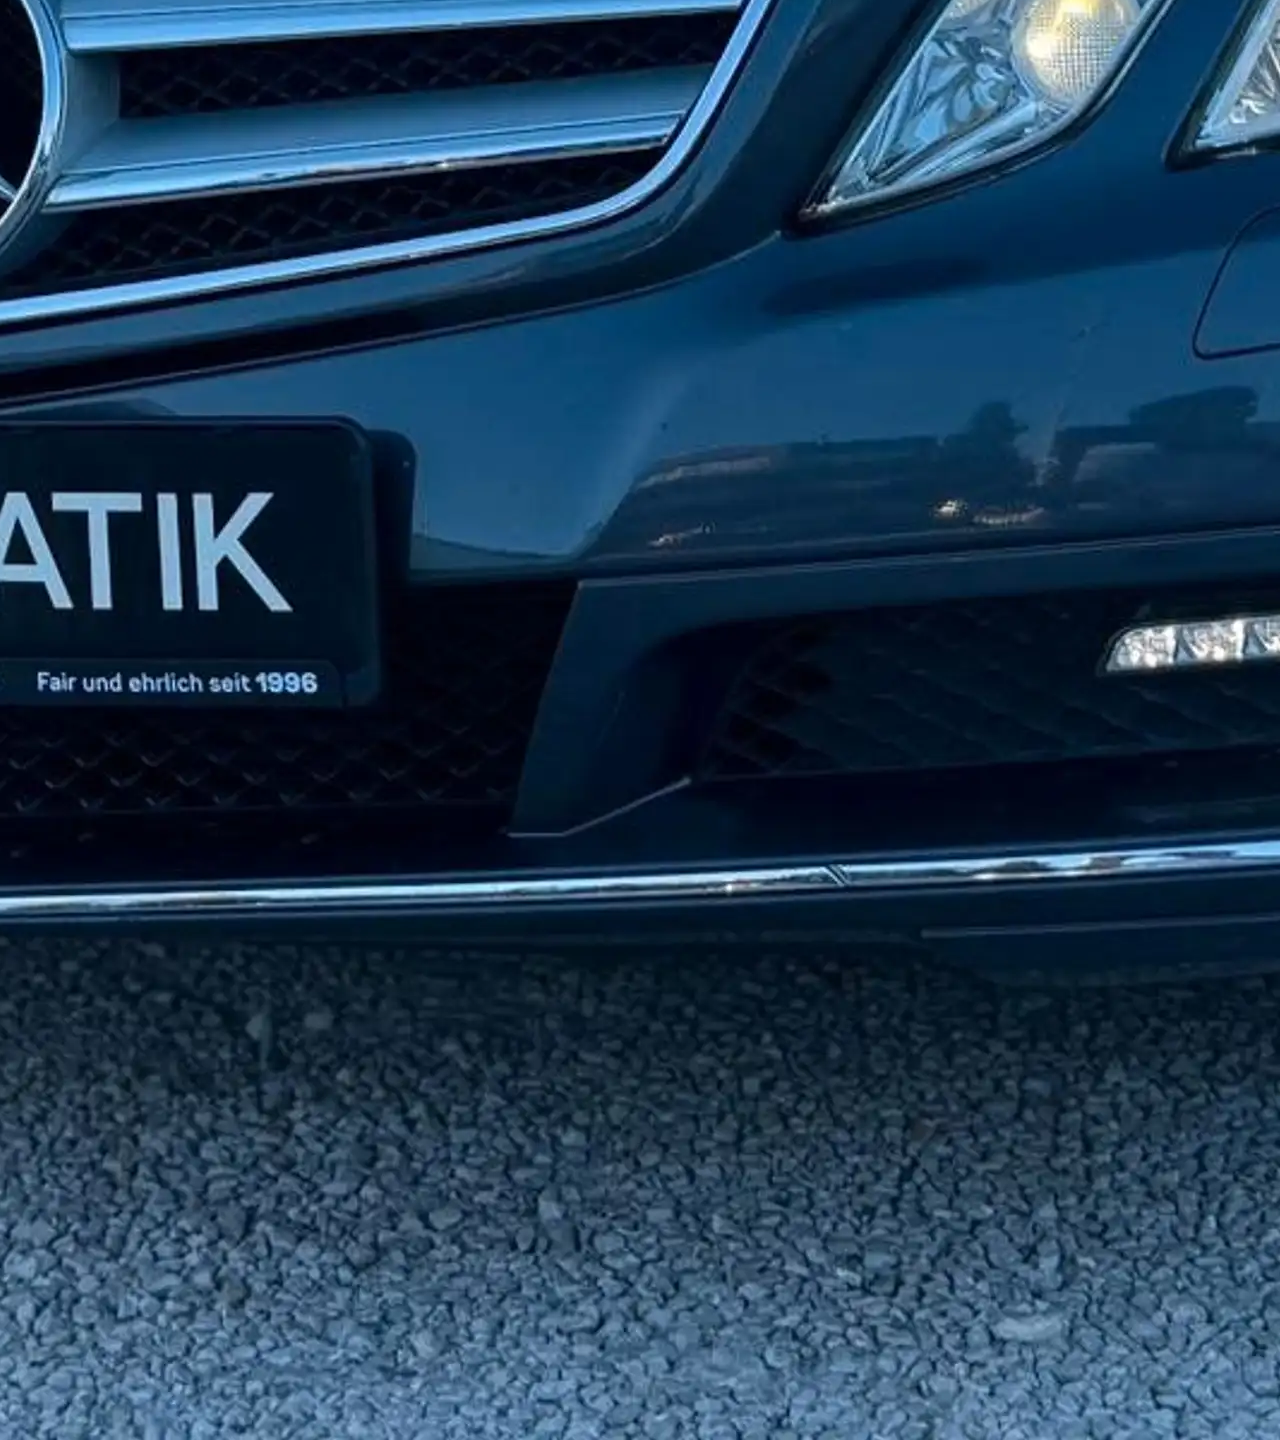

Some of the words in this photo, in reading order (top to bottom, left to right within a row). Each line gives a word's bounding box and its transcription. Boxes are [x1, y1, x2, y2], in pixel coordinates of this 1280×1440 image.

[36, 671, 77, 693] Fair
[81, 671, 123, 693] und
[128, 671, 204, 693] ehrlich
[208, 671, 253, 693] seit
[254, 671, 319, 695] 1996
